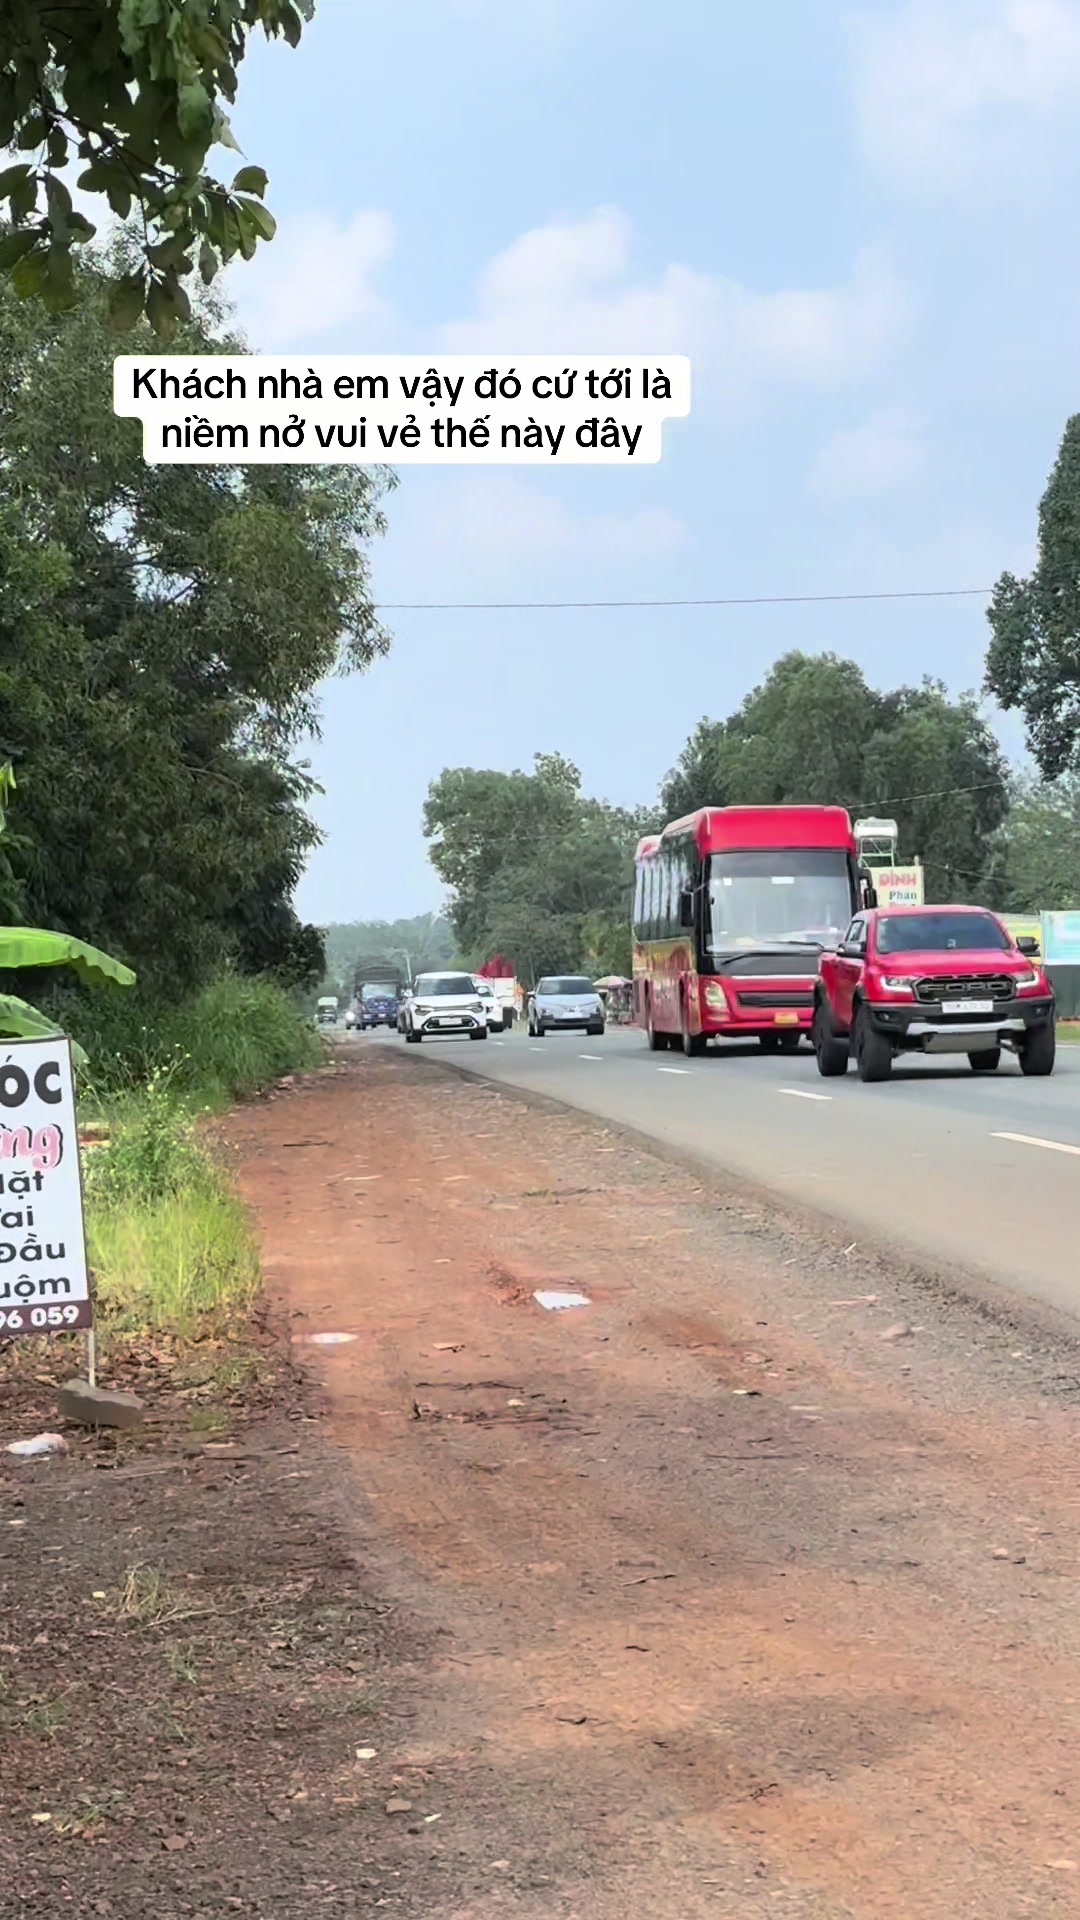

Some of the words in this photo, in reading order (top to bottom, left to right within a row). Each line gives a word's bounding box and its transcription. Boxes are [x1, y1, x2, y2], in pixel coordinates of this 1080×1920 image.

[0, 1123, 63, 1169] ng
[0, 1170, 44, 1200] ặt
[0, 1205, 34, 1228] ai
[31, 1305, 80, 1327] 059
